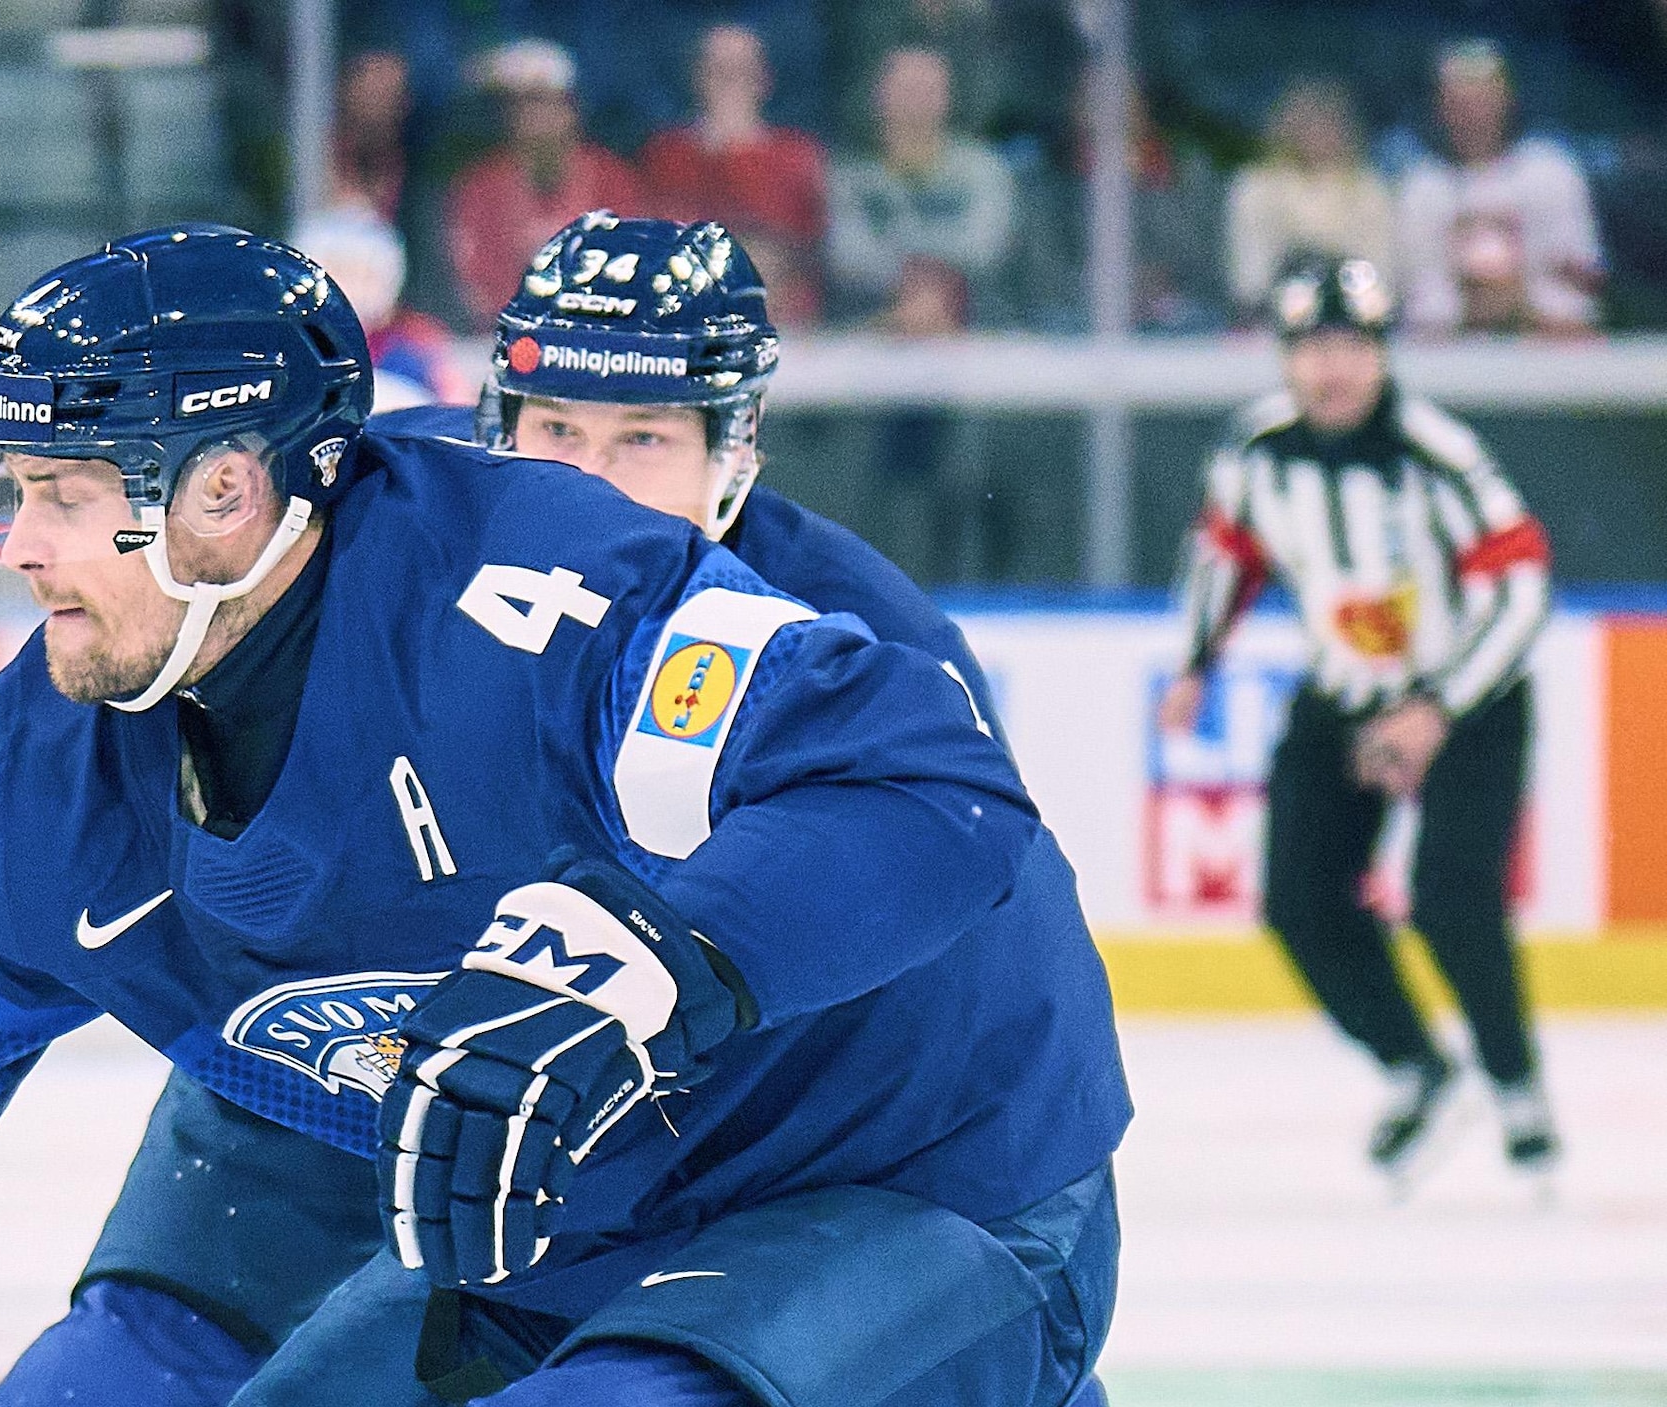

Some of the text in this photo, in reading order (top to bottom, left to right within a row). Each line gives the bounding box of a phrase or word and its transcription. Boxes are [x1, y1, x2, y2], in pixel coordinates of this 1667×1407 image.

[542, 344, 688, 378] Pihlajalinna
[181, 379, 272, 414] CCM
[115, 533, 154, 544] CCM
[455, 563, 613, 655] 4
[389, 755, 458, 881] A
[266, 992, 418, 1050] SUOM
